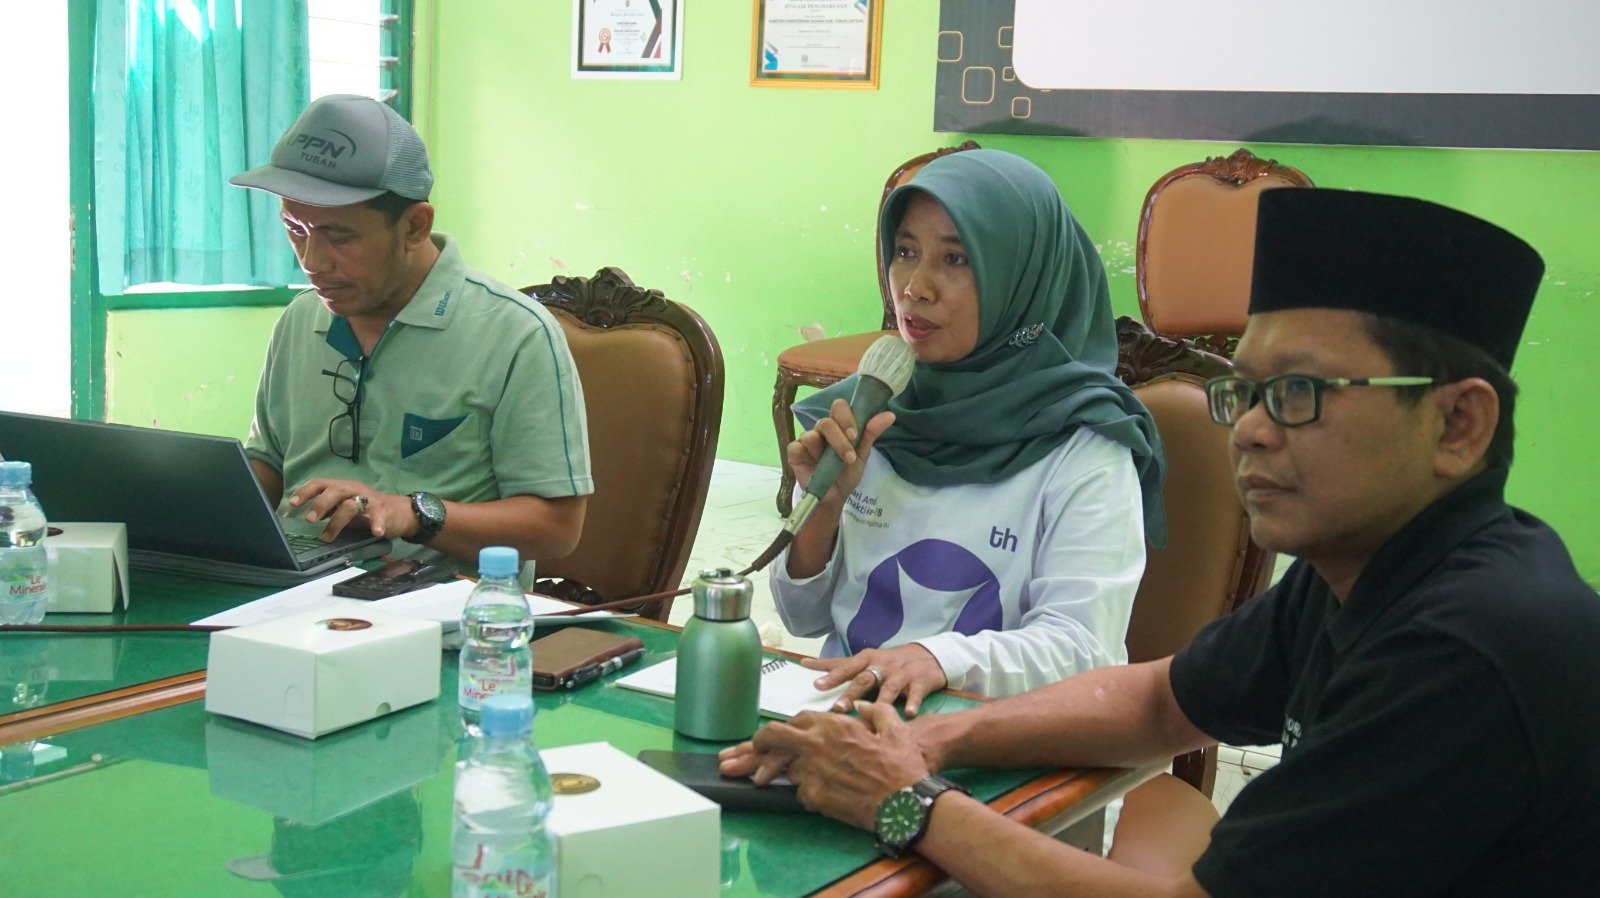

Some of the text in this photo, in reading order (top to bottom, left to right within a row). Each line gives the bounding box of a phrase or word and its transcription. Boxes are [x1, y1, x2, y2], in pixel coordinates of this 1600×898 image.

[300, 152, 337, 169] TUBAN
[846, 497, 867, 515] hakti
[989, 525, 1018, 552] th
[481, 679, 497, 692] Le
